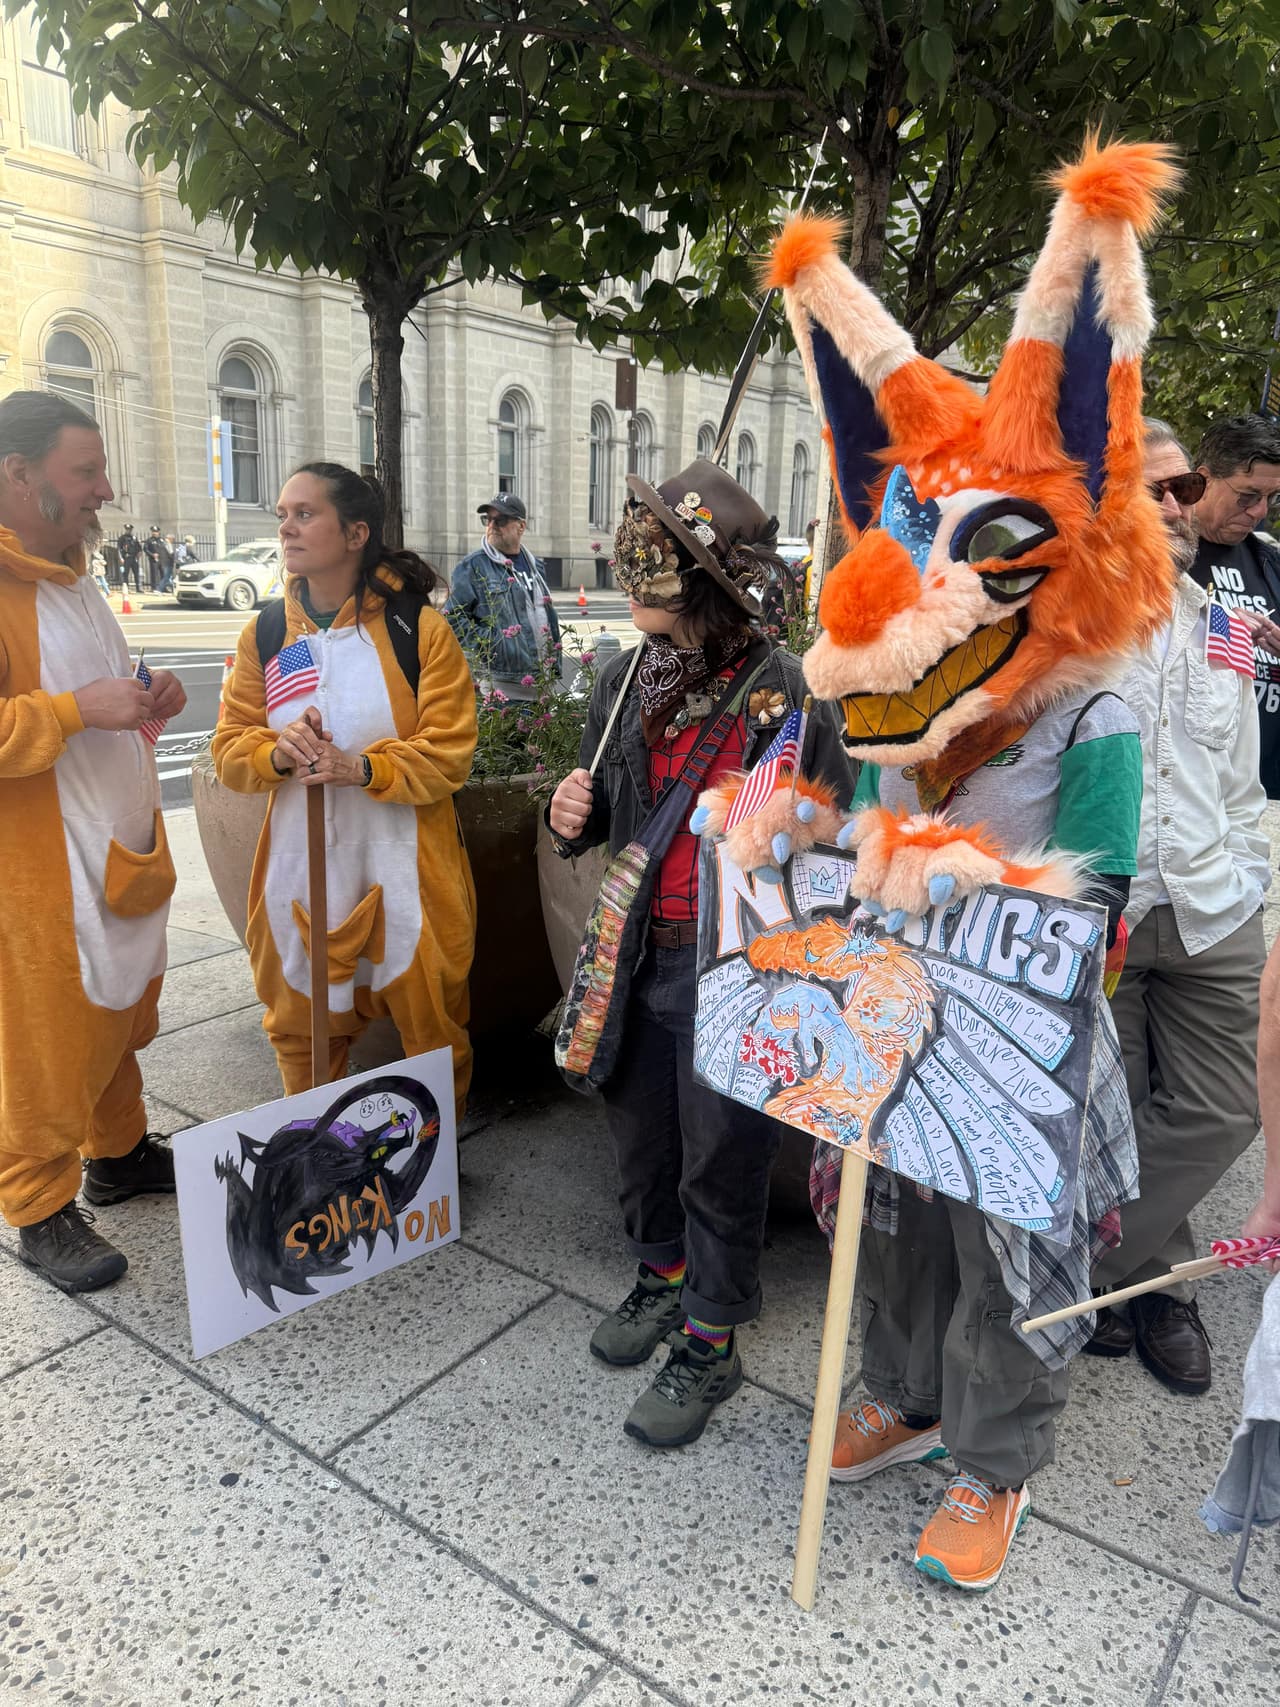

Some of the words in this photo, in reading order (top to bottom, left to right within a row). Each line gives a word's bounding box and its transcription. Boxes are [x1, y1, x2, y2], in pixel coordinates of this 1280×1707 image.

[1210, 565, 1245, 592] NO
[1212, 590, 1268, 618] INGS
[963, 976, 974, 989] is
[1026, 1007, 1042, 1018] on
[936, 1041, 945, 1051] A
[980, 1084, 992, 1094] is
[929, 1126, 942, 1139] is
[961, 1098, 984, 1123] they
[1009, 1159, 1021, 1173] to
[1024, 1185, 1040, 1211] the
[284, 1175, 393, 1260] KINGS
[404, 1195, 451, 1243] NO
